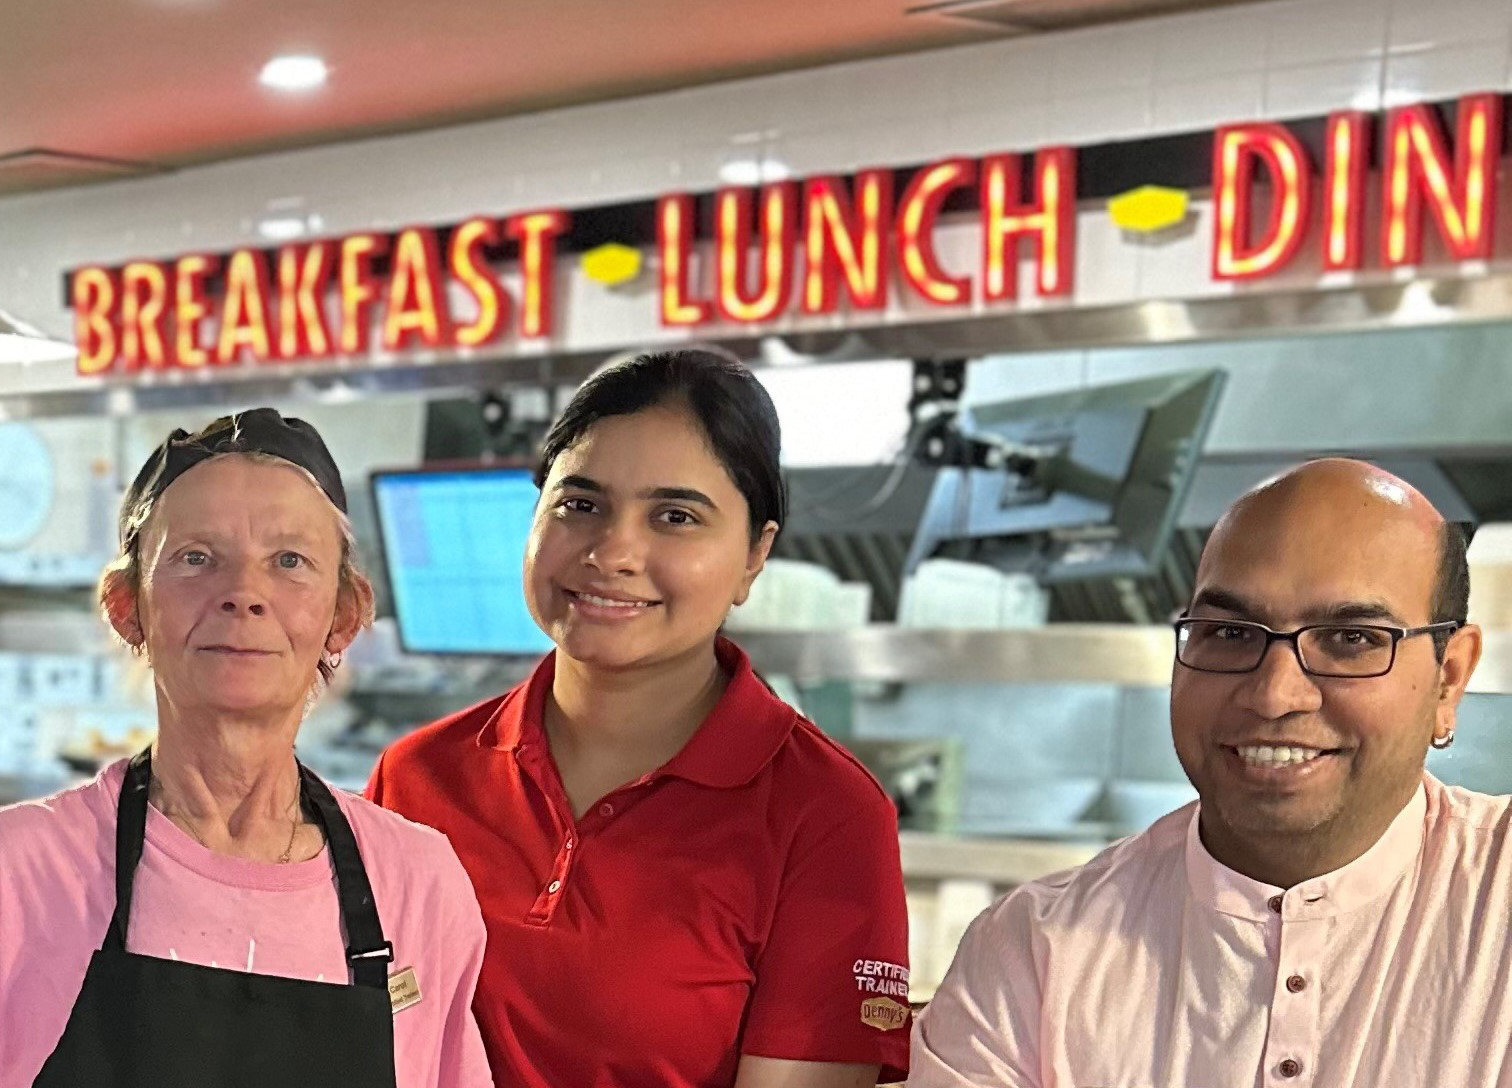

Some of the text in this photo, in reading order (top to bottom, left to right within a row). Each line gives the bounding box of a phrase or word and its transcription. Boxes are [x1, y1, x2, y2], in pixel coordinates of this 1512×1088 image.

[73, 91, 1502, 376] BREAKFAST LUNCH DIN
[863, 1003, 904, 1023] Denny's
